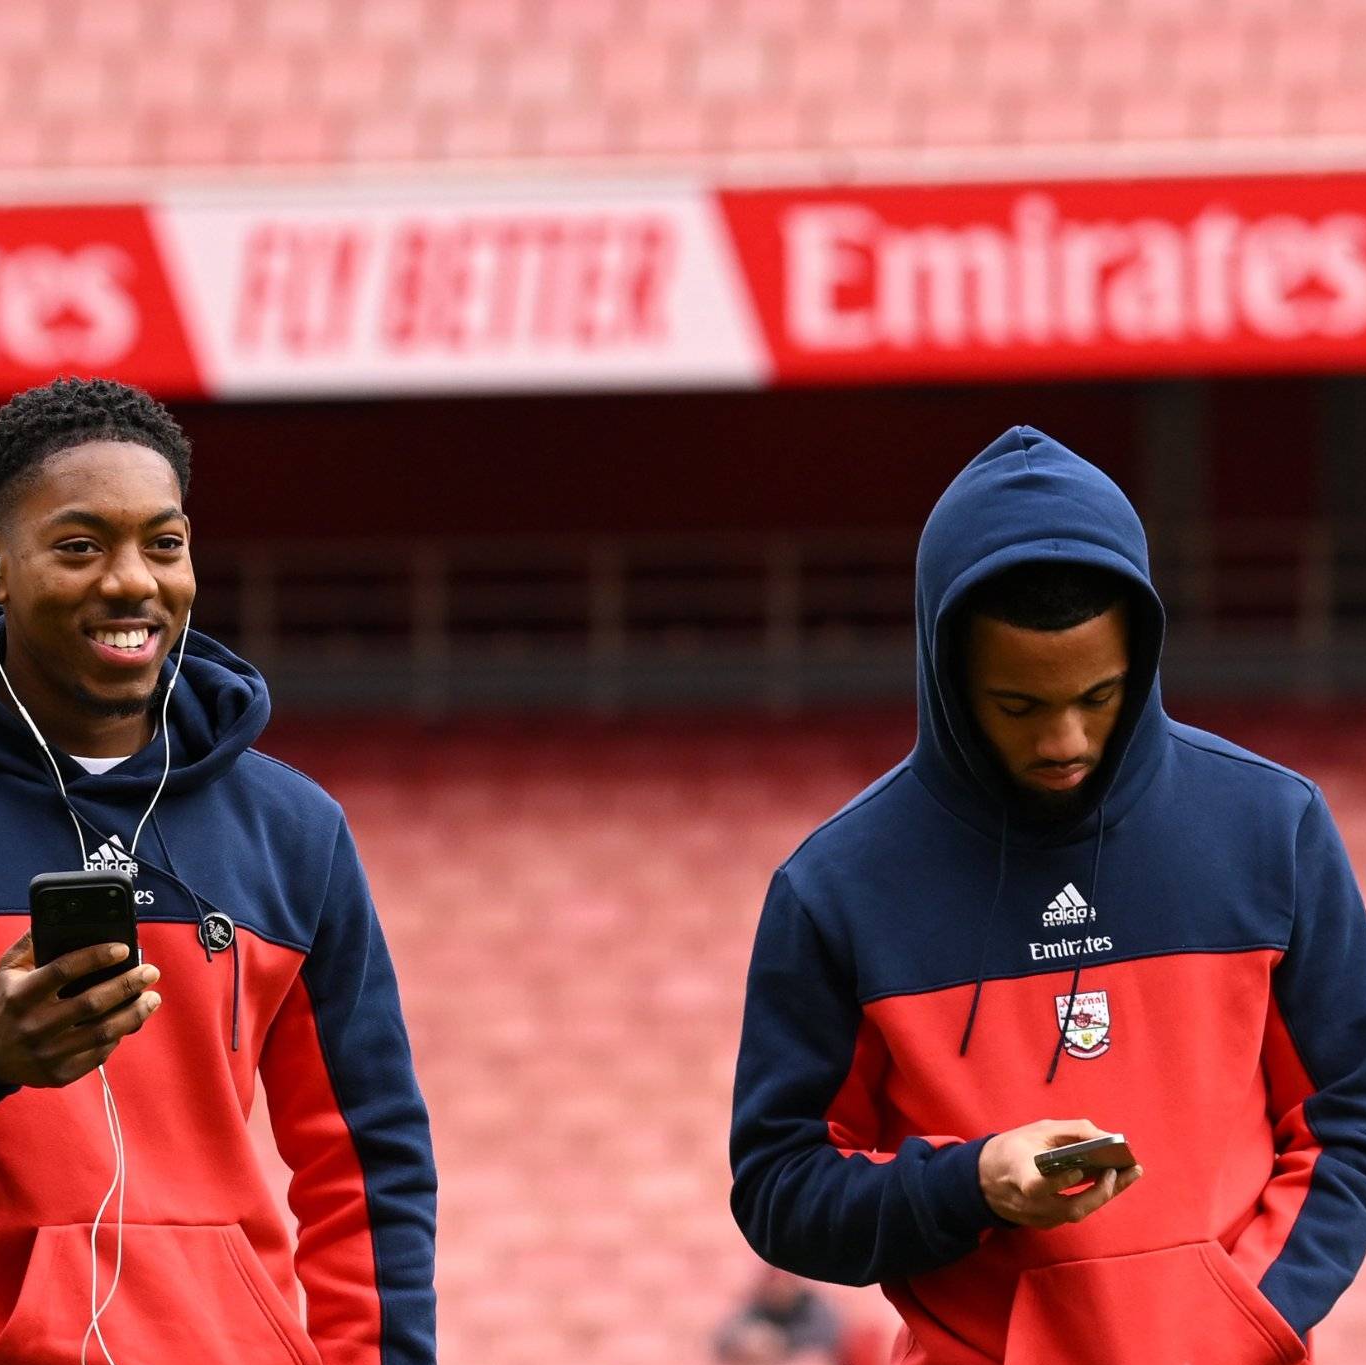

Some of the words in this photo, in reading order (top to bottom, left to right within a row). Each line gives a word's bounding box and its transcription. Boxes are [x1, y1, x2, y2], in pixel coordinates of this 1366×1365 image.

[238, 218, 374, 356] FLY
[377, 211, 678, 354] BETTER
[83, 860, 139, 874] adidas
[1042, 906, 1097, 922] adidas
[1059, 993, 1105, 1008] Asenal
